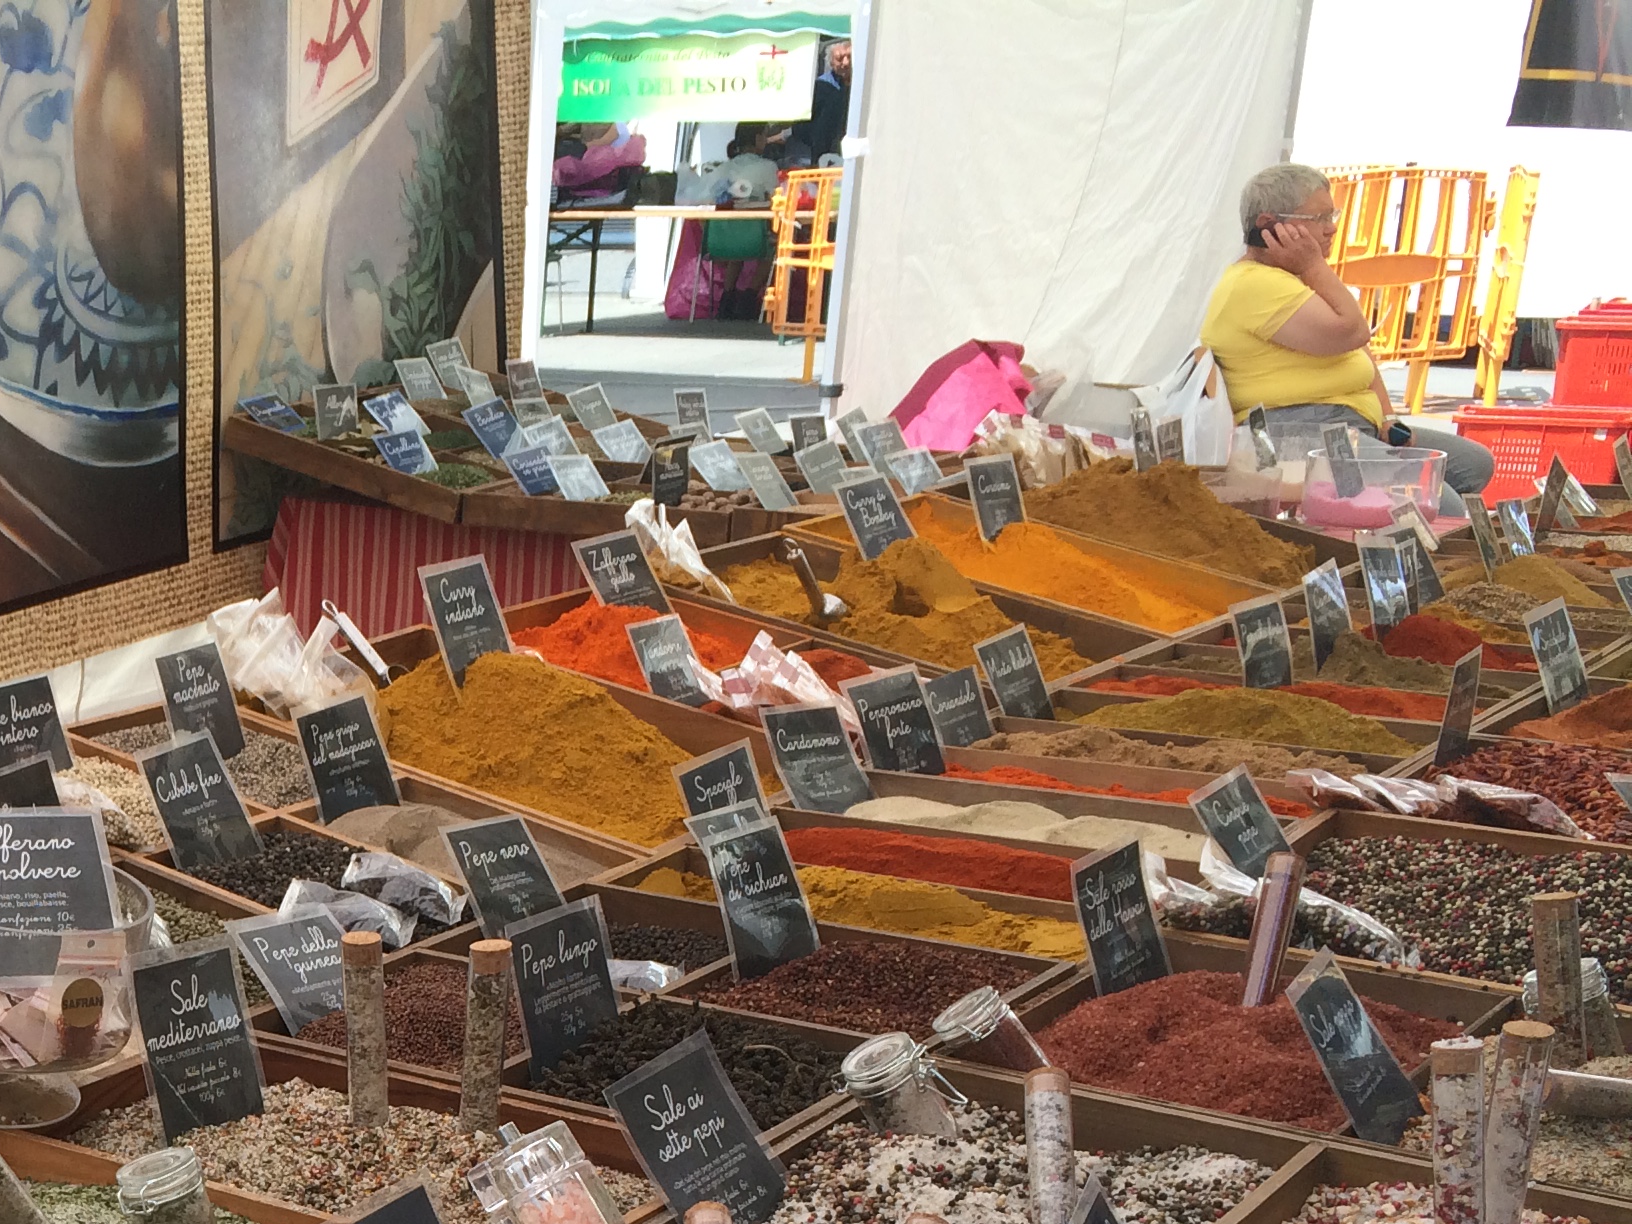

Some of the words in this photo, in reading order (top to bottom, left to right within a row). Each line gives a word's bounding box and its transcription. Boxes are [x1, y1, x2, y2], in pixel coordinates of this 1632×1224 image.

[638, 77, 675, 96] DEL
[683, 77, 747, 94] PESTO
[846, 489, 880, 513] Curry
[440, 577, 476, 609] Curry
[445, 602, 485, 625] indiano
[176, 656, 206, 685] Pepe
[173, 675, 220, 704] macinato
[10, 694, 54, 723] bianco
[0, 725, 40, 746] intero
[884, 722, 912, 750] forte
[155, 768, 199, 804] Cubebe
[459, 840, 498, 877] Pepe
[498, 840, 531, 862] nero
[1084, 870, 1110, 911] Sale
[56, 911, 76, 923] 10€
[1089, 903, 1114, 942] delle
[252, 936, 300, 970] Pepe
[300, 925, 339, 953] della
[520, 943, 556, 988] Pepe
[556, 929, 599, 969] lungo
[293, 953, 343, 985] guinea
[170, 973, 209, 1016] Sale
[147, 1013, 242, 1053] mediterraneo
[643, 1082, 687, 1132] Sale
[687, 1086, 705, 1111] ai
[658, 1128, 693, 1163] sette
[692, 1109, 726, 1158] pepi
